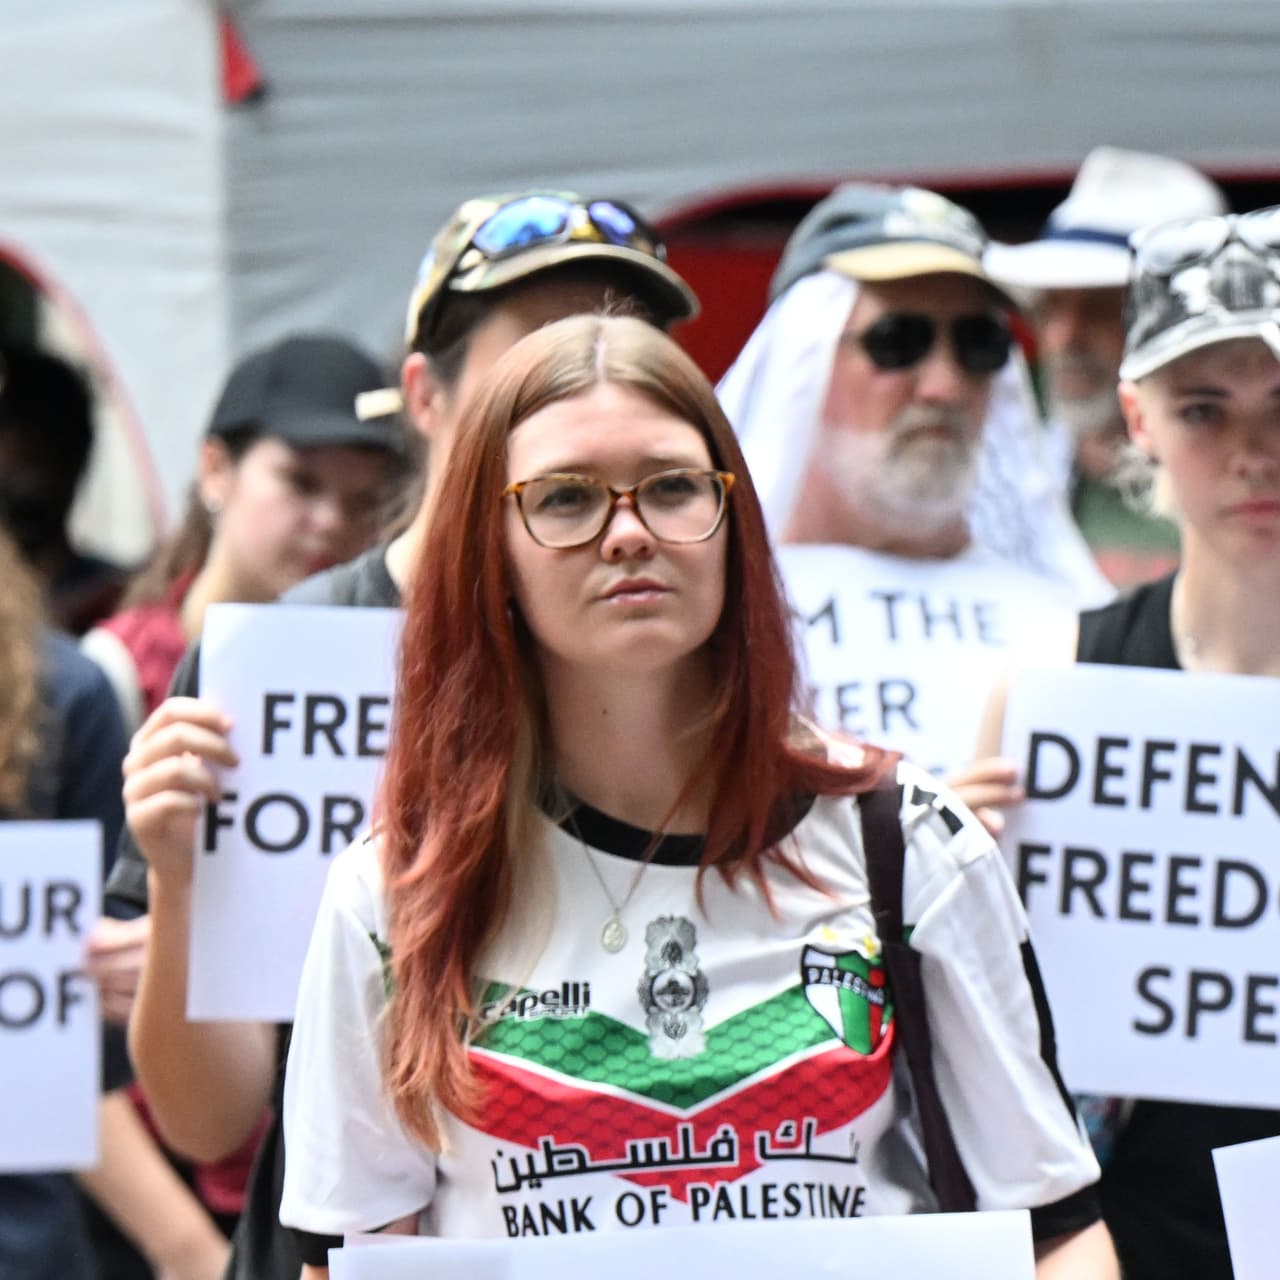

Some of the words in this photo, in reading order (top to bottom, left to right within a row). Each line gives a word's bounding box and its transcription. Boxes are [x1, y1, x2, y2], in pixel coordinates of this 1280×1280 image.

[262, 692, 390, 758] FRE
[203, 792, 366, 855] FOR
[502, 1196, 596, 1237] BANK
[616, 1189, 668, 1227] OF
[689, 1182, 866, 1222] PALESTINE
